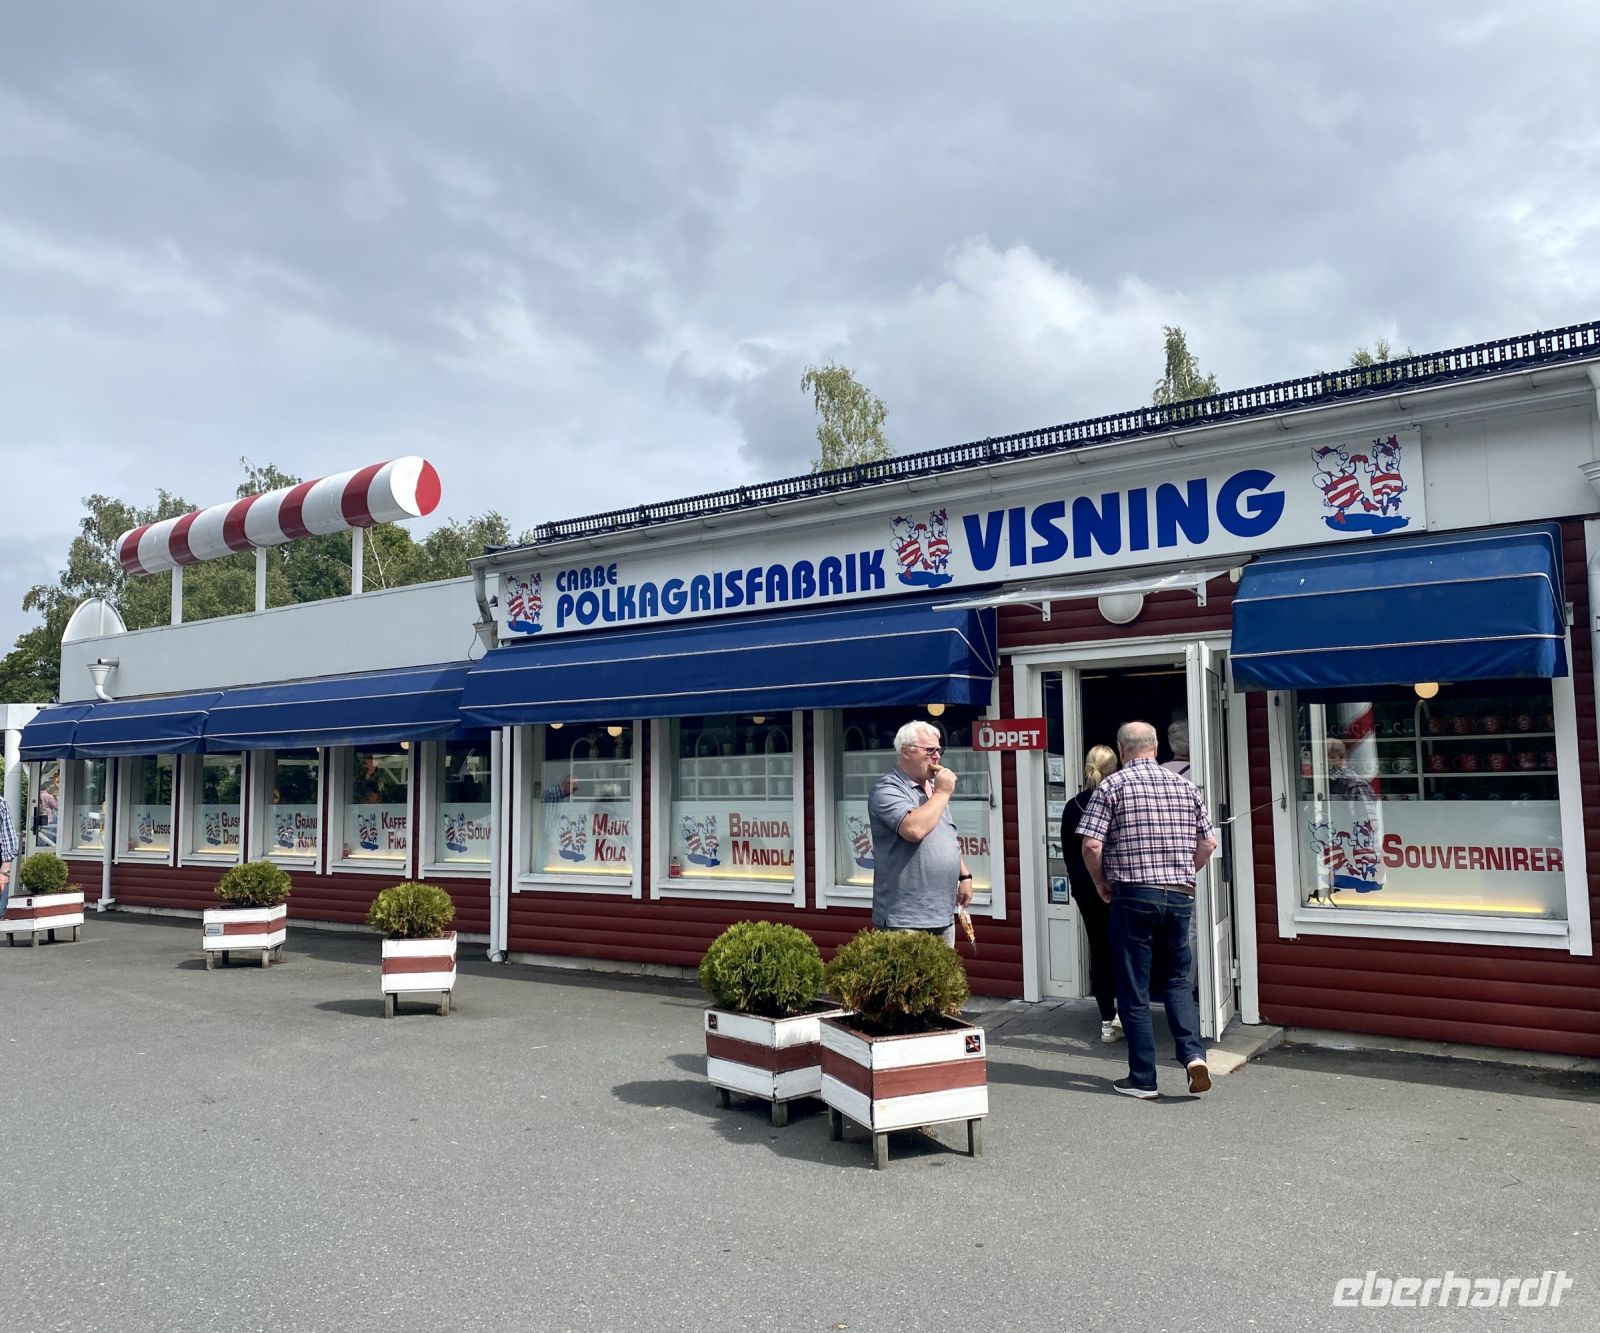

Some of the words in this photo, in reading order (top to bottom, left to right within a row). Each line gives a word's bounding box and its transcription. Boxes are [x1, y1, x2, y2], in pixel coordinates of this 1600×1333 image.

[962, 469, 1285, 571] VISNING
[556, 563, 617, 592] CABBE
[556, 549, 886, 628] POLKAGRISFABRIK
[978, 722, 1040, 748] ÖPPET
[381, 811, 407, 829] KAFFE
[592, 813, 630, 836] MJUK
[728, 812, 790, 838] BRÄNDA
[594, 838, 626, 862] KOLA
[956, 836, 990, 856] RISA
[1382, 833, 1564, 872] SOUVERNIRER
